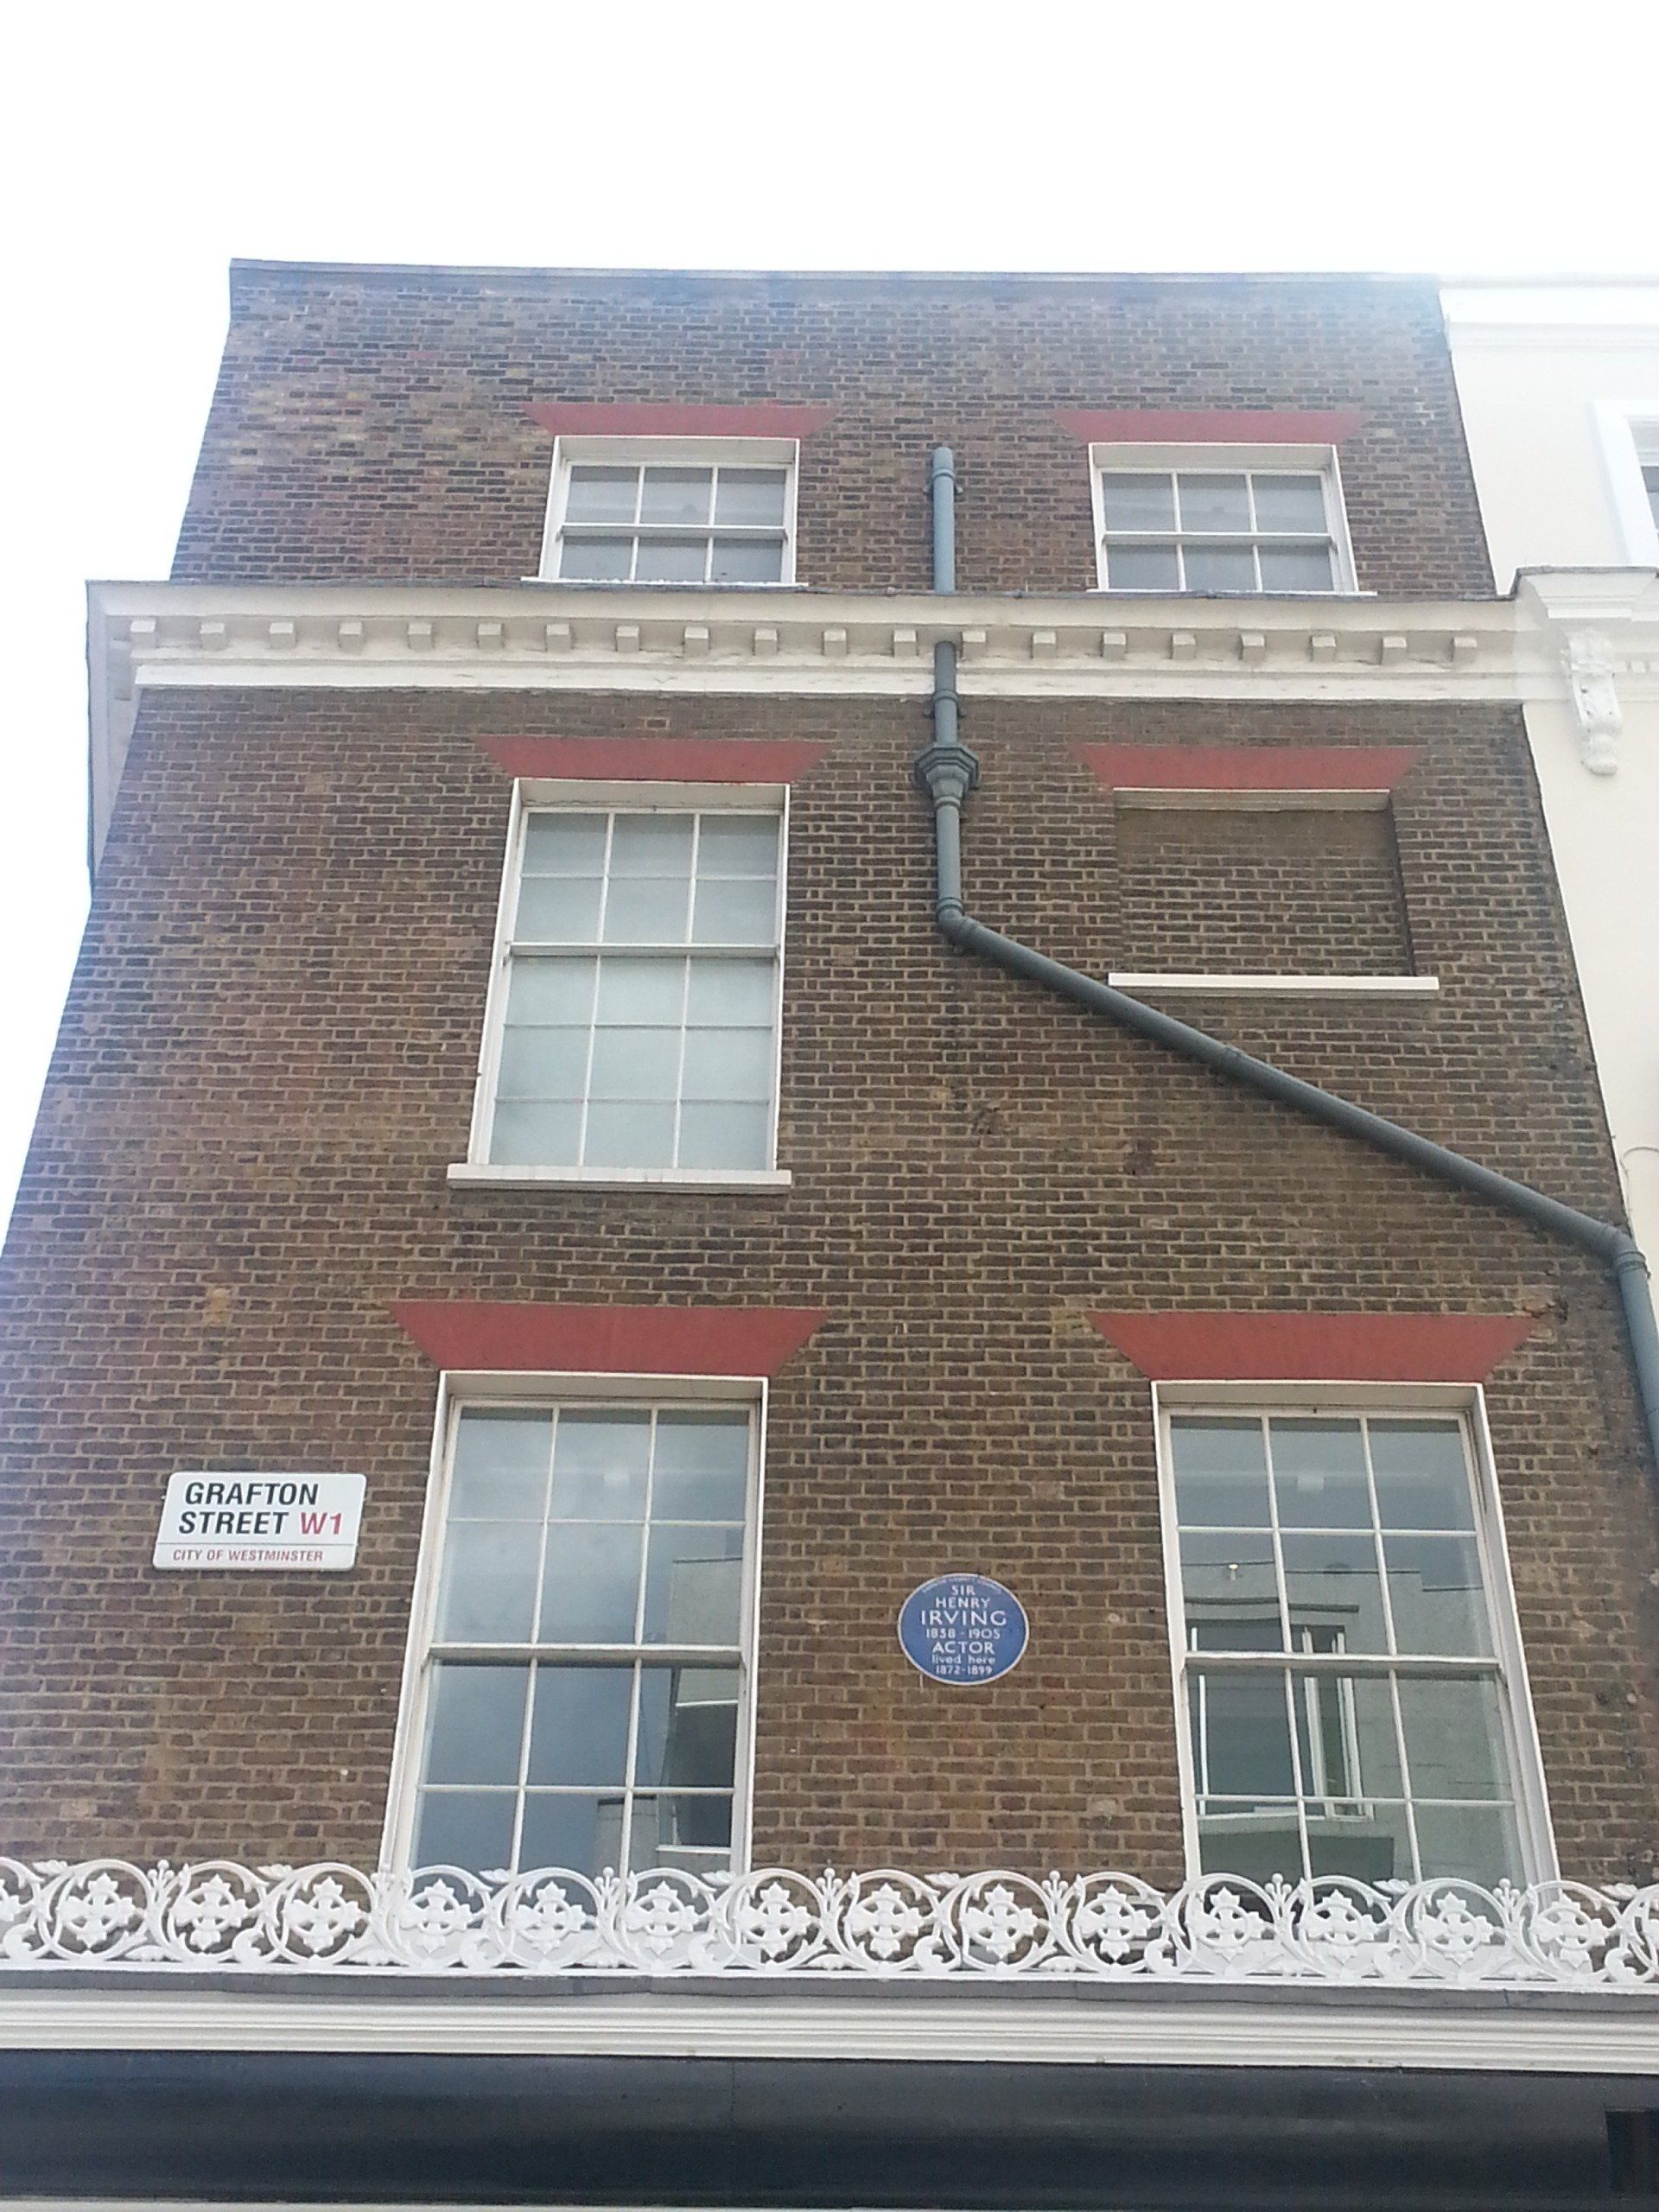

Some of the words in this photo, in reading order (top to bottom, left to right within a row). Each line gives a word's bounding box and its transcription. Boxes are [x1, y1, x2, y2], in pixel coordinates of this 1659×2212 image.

[185, 1482, 319, 1505] GRAFTON
[178, 1511, 289, 1535] STREET
[302, 1512, 342, 1535] W1
[173, 1549, 202, 1561] CITY
[207, 1549, 224, 1561] OF
[228, 1550, 323, 1562] WESTMINSTER
[951, 1585, 976, 1596] SIR
[935, 1597, 991, 1609] HENRY
[920, 1610, 1007, 1626] IRVING
[969, 1628, 1001, 1639] 1905
[932, 1642, 995, 1654] ACTOR
[931, 1654, 961, 1664] lived
[968, 1654, 995, 1664] here
